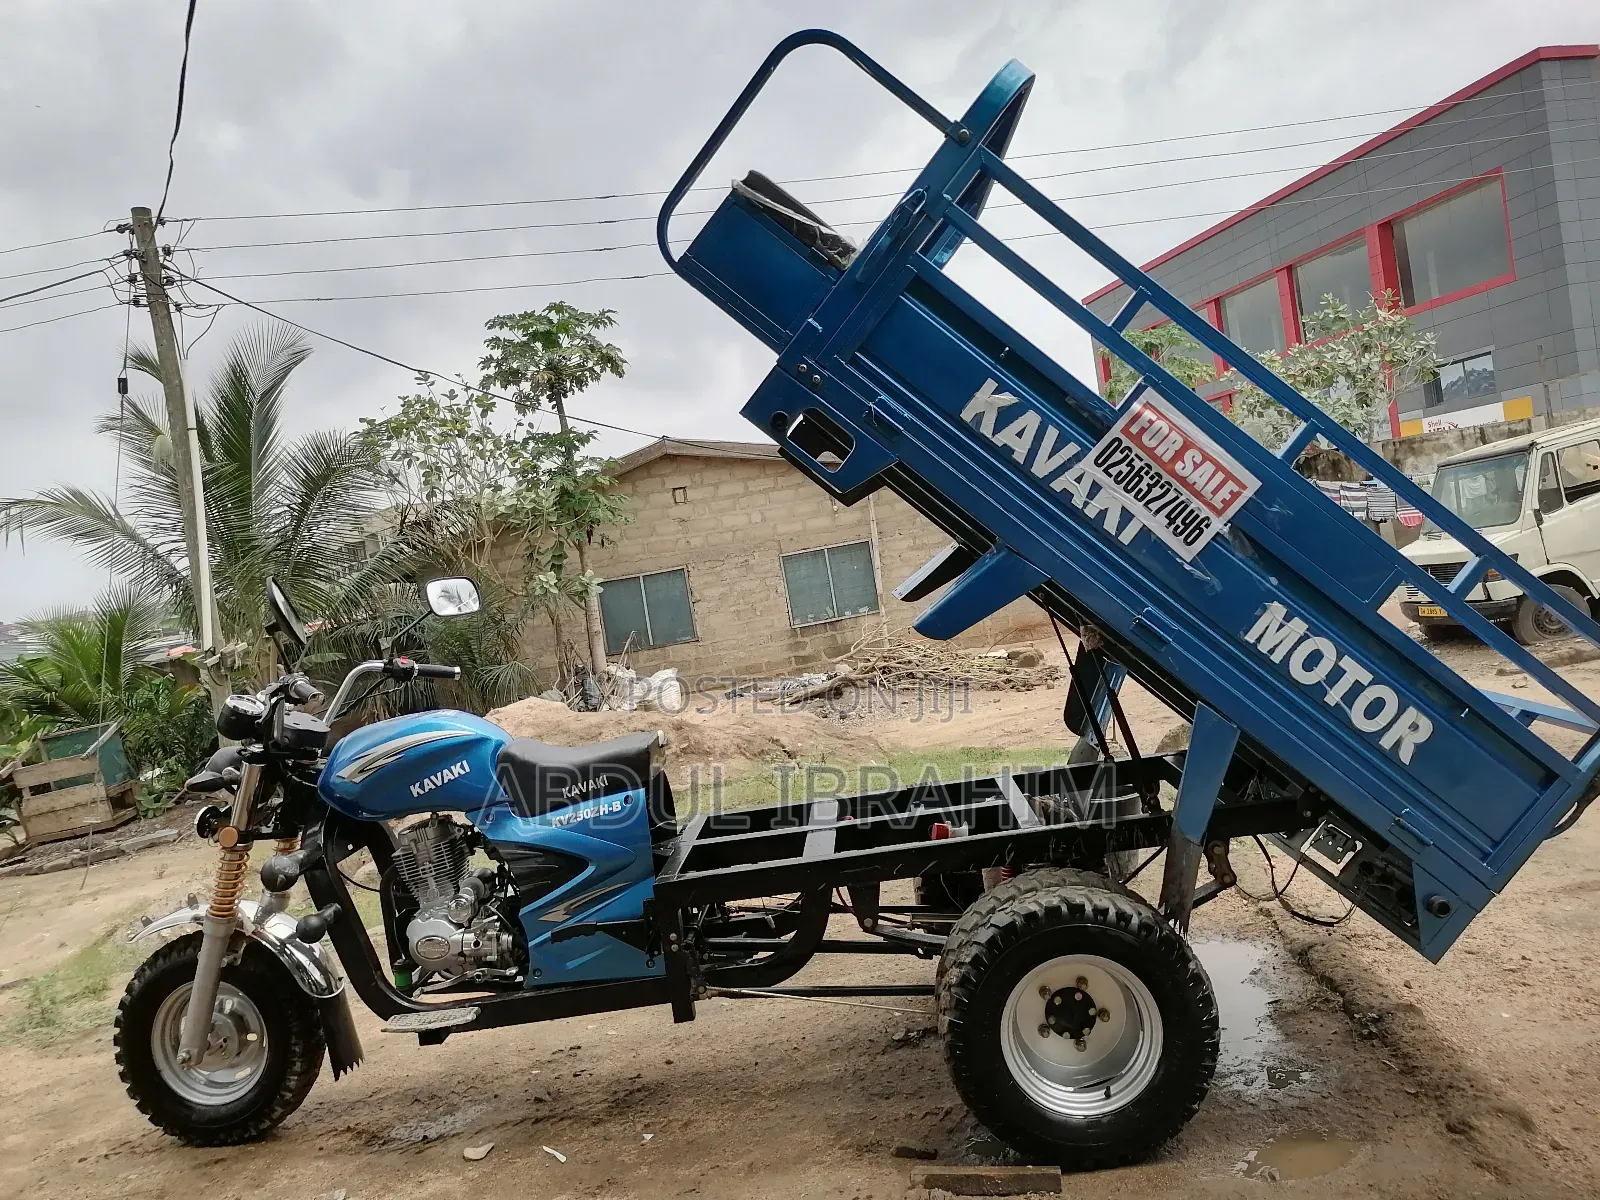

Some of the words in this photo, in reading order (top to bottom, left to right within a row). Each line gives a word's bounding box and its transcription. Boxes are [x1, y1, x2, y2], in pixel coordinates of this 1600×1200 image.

[1427, 419, 1442, 428] Shell
[959, 378, 1144, 546] KAVAKI
[1093, 436, 1213, 547] 0256327496
[1129, 409, 1184, 470] FOR
[1175, 452, 1242, 509] SALE
[1243, 600, 1433, 766] MOTOR
[409, 760, 471, 797] KAVAKI
[561, 775, 609, 798] KAVAKI
[551, 800, 622, 828] KV250ZH-B
